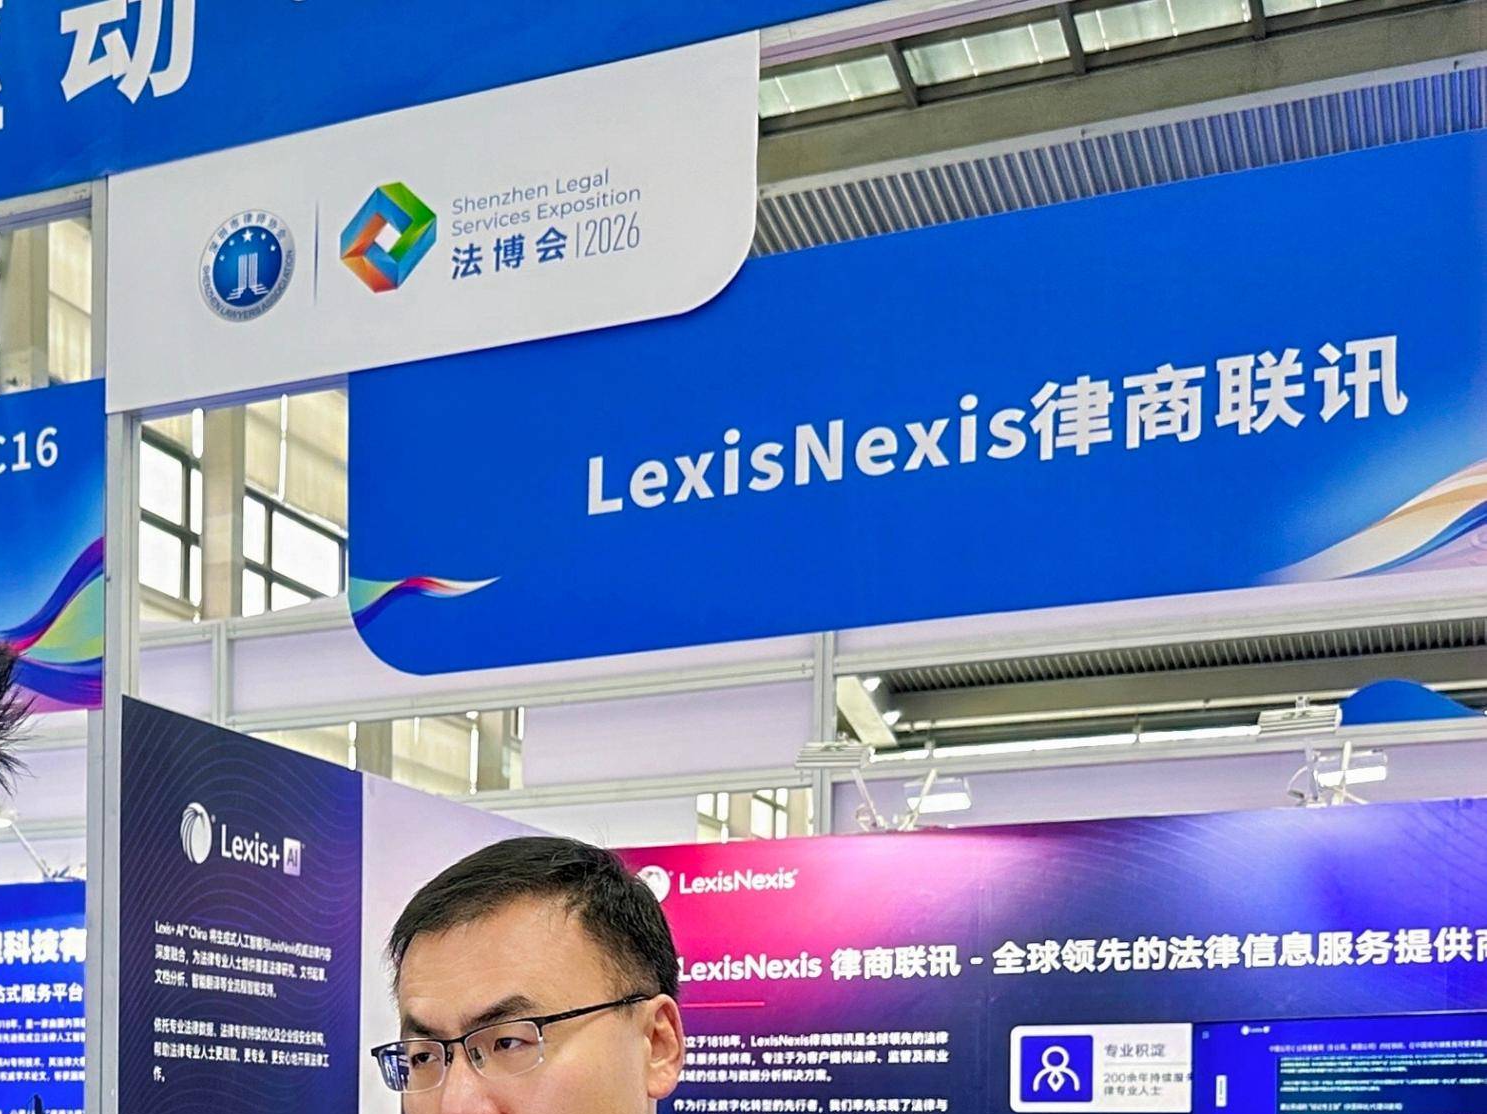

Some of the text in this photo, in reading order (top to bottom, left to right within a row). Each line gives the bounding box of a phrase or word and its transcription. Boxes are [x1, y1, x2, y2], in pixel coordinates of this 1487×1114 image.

[452, 168, 610, 215] Shenzhen Legal
[452, 186, 641, 237] Services Exposition
[451, 212, 641, 280] 法博会 2026
[586, 335, 1408, 515] LexisNexis律商联讯
[220, 824, 281, 869] Lexis+
[679, 868, 796, 896] LexisNexis
[678, 951, 822, 982] LexisNexis
[830, 945, 961, 981] 律商联讯
[684, 1050, 949, 1065] 息服务提供商，专注于为客户提供法律、监管及商业
[1105, 1043, 1165, 1058] 专业积淀
[1104, 1086, 1162, 1096] 律专业人士
